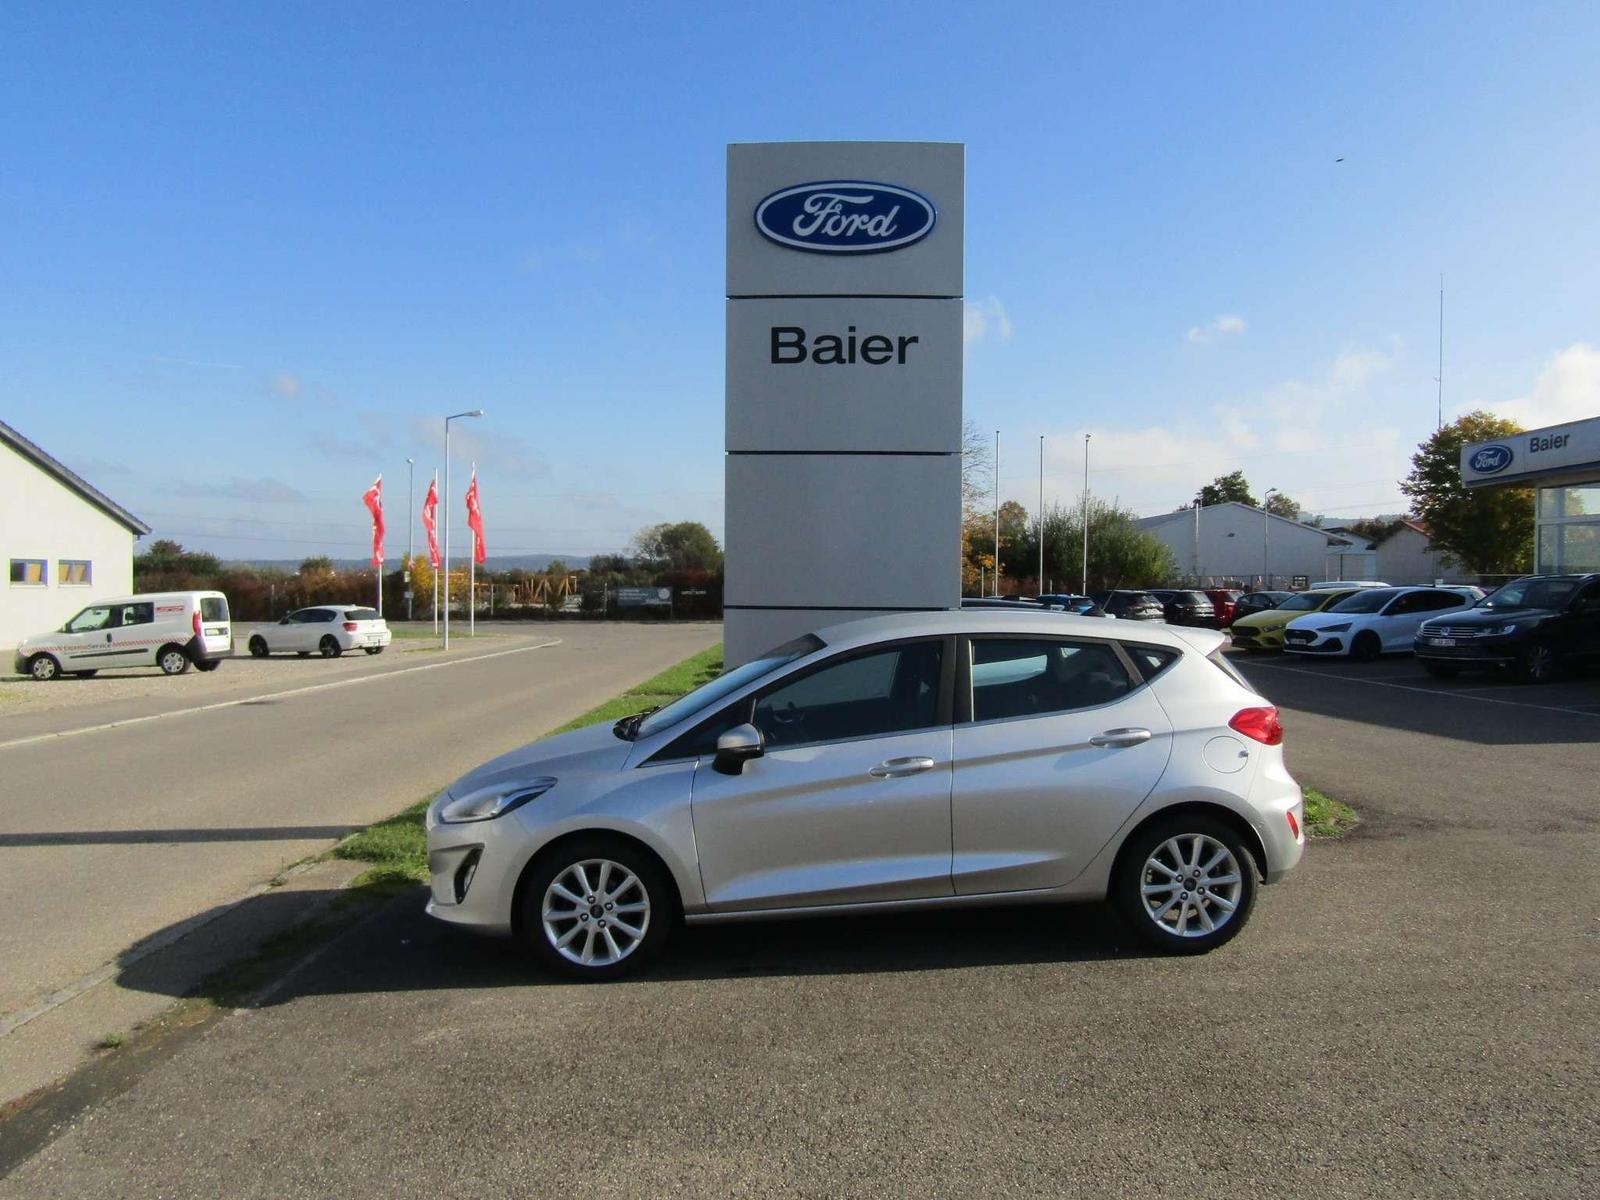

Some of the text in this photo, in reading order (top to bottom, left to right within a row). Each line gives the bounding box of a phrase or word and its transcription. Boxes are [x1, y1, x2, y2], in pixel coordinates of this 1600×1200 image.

[792, 193, 900, 237] Ford
[771, 326, 919, 365] Baier
[1529, 433, 1570, 453] Baier
[1474, 450, 1502, 469] Ford
